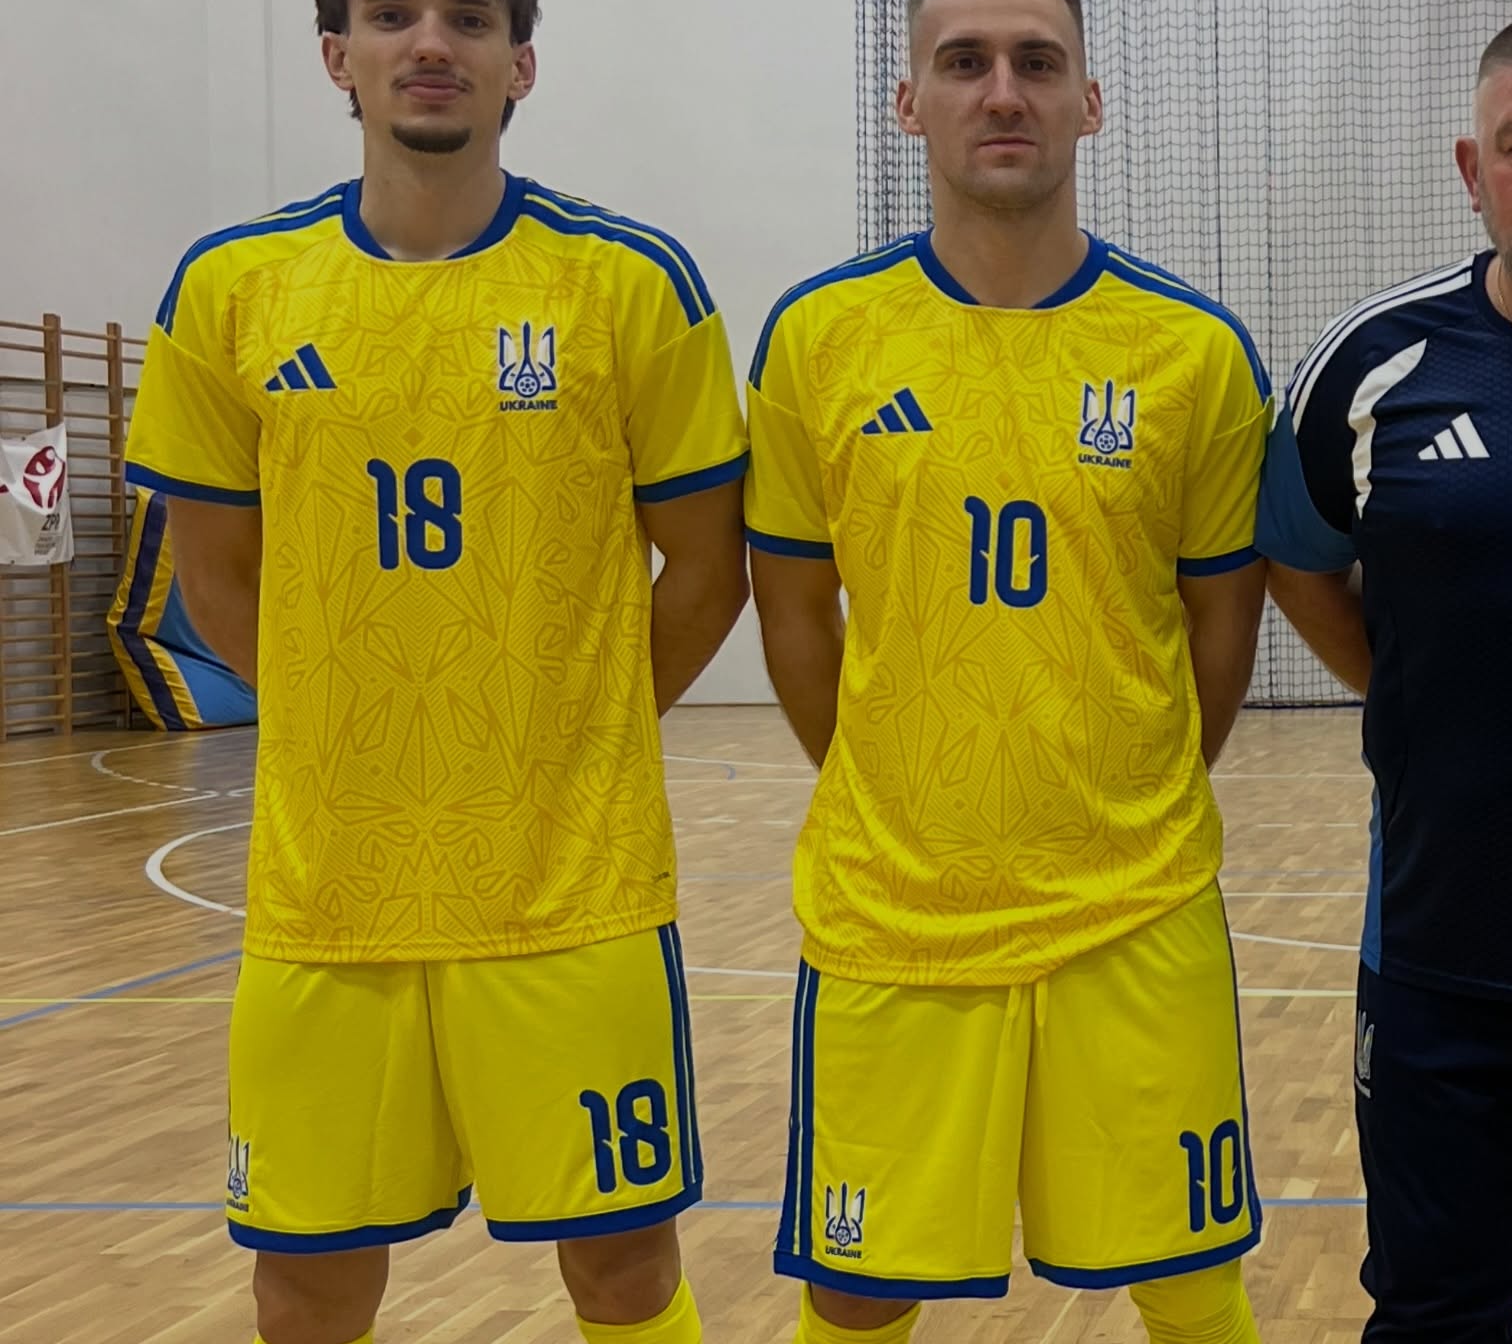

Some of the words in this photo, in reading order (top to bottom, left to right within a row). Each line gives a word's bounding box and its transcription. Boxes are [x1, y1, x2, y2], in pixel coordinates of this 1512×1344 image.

[499, 399, 558, 412] UKRAINE
[1078, 453, 1133, 468] UKRAINE
[366, 459, 462, 570] 18
[964, 496, 1048, 608] 10
[579, 1078, 672, 1193] 18
[1179, 1119, 1244, 1233] 10
[825, 1245, 863, 1260] UKRAINE
